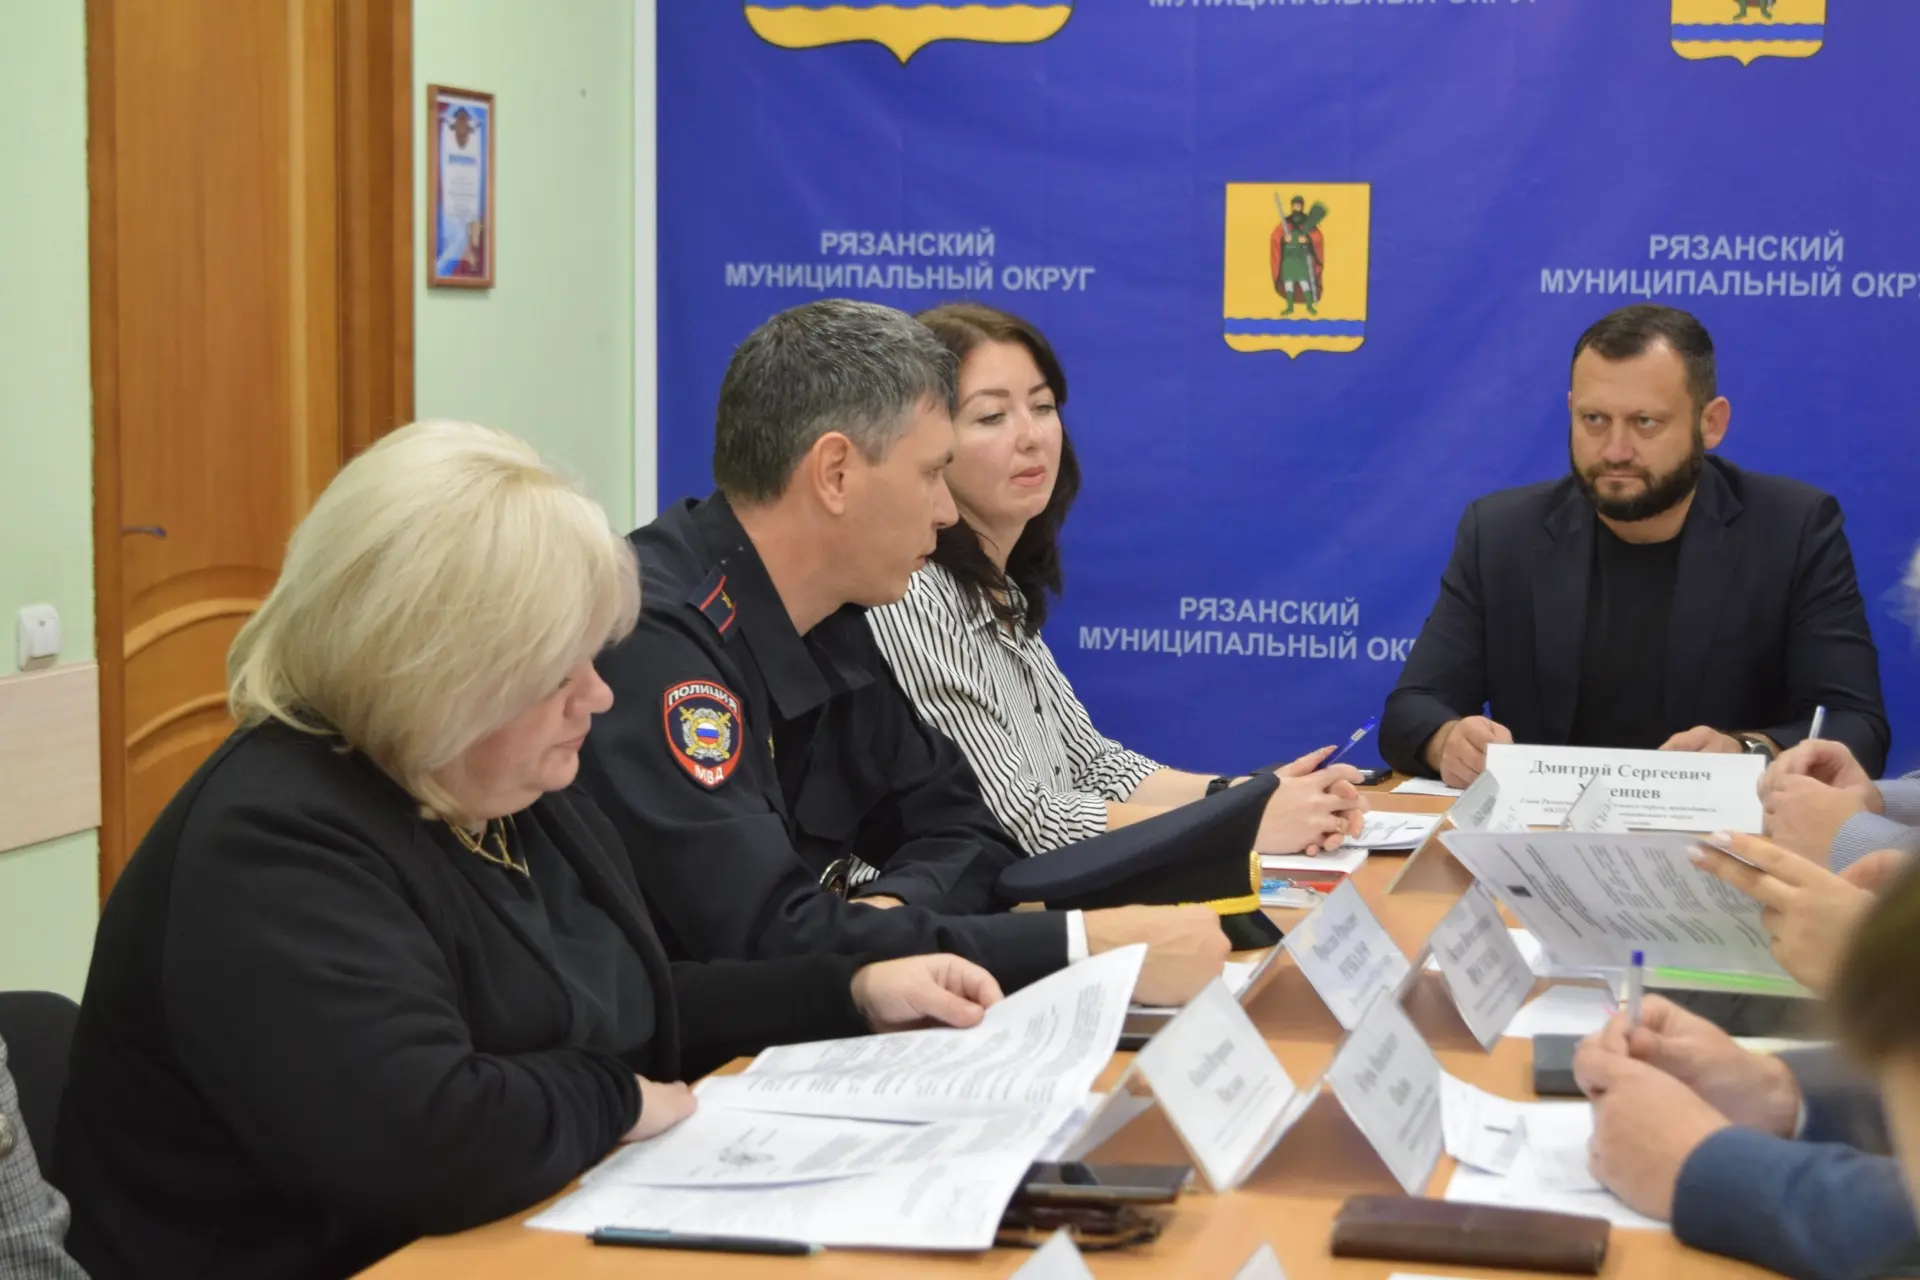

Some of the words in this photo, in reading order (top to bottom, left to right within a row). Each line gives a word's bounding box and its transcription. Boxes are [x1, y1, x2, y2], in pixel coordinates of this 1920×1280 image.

[820, 227, 995, 256] РЯЗАНСКИЙ
[1649, 229, 1845, 261] РЯЗАНСКИЙ
[725, 260, 994, 291] МУНИЦИПАЛЬНЫЙ
[1002, 265, 1096, 291] ОКРУГ
[1540, 265, 1842, 299] МУНИЦИПАЛЬНЫЙ
[1851, 271, 1920, 298] ОКР
[1179, 597, 1360, 626] РЯЗАНСКИЙ
[1079, 627, 1358, 660] МУНИЦИПАЛЬНЫЙ
[668, 684, 738, 713] ПОЛИЦИЯ
[694, 764, 725, 785] МВД
[1529, 760, 1612, 778] Дмитрий
[1617, 763, 1712, 781] Сергеевич
